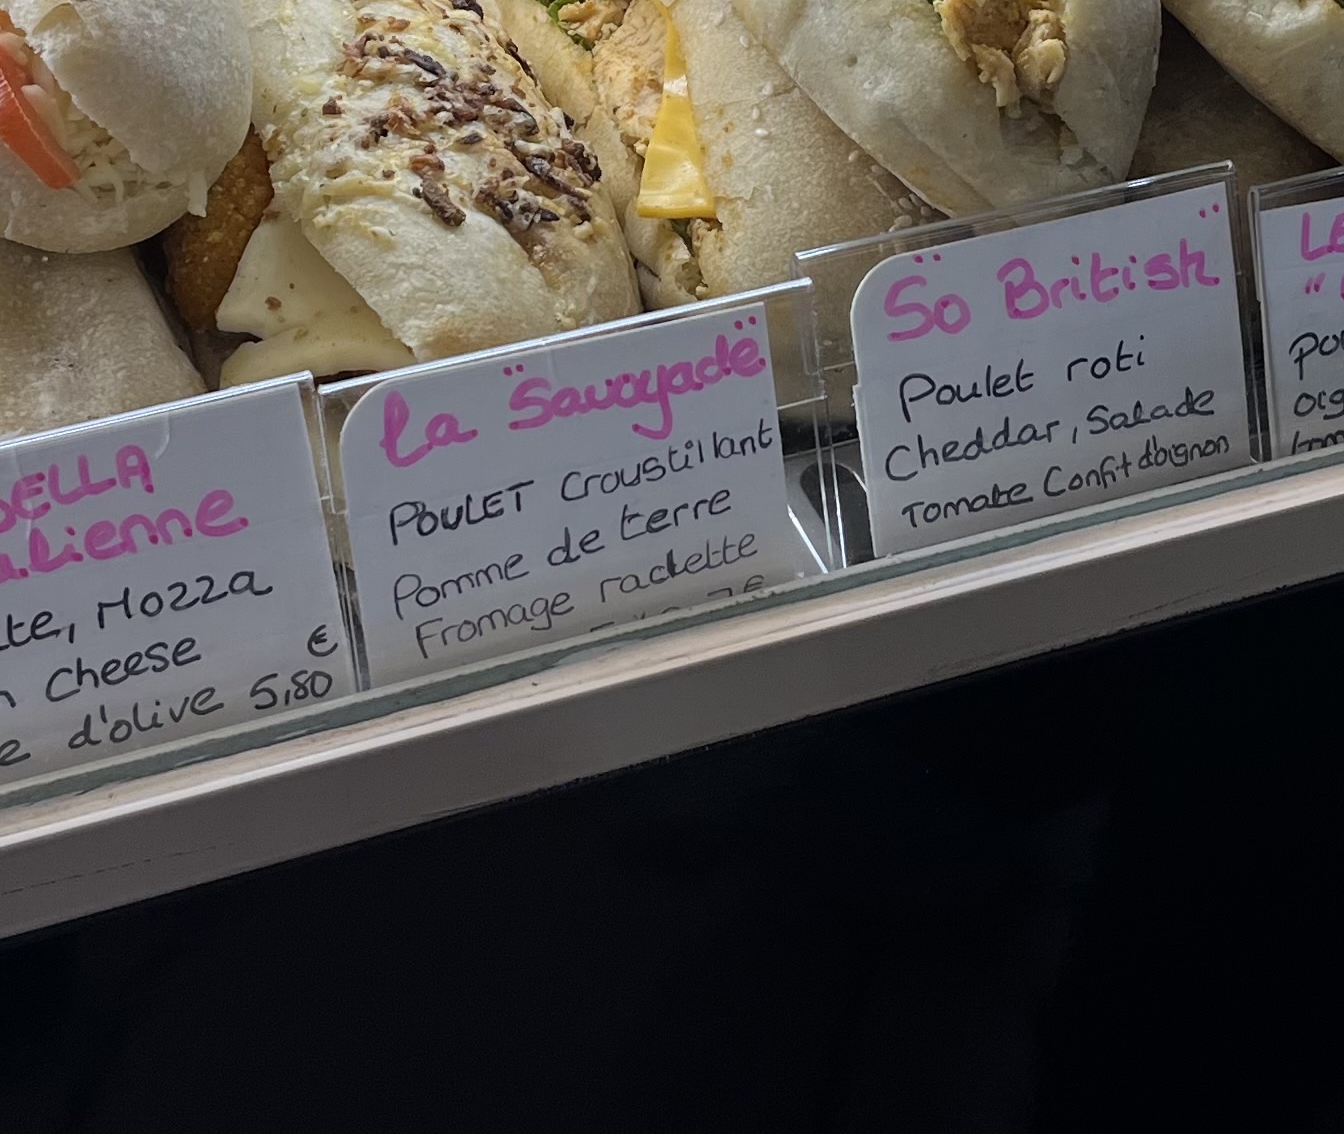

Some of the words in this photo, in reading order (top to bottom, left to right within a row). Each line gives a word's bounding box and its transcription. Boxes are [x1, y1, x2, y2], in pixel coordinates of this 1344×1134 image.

[900, 360, 1035, 423] Poulet
[1067, 335, 1146, 382] roti
[902, 482, 1033, 528] Tomate
[394, 552, 529, 621] Pomme
[548, 528, 605, 567] de
[620, 489, 732, 540] terre
[416, 592, 575, 658] Fromage
[600, 532, 758, 603] raclette
[98, 570, 273, 629] Mozza
[307, 625, 339, 658] €
[67, 686, 224, 750] d'olive
[249, 670, 333, 709] 5,80
